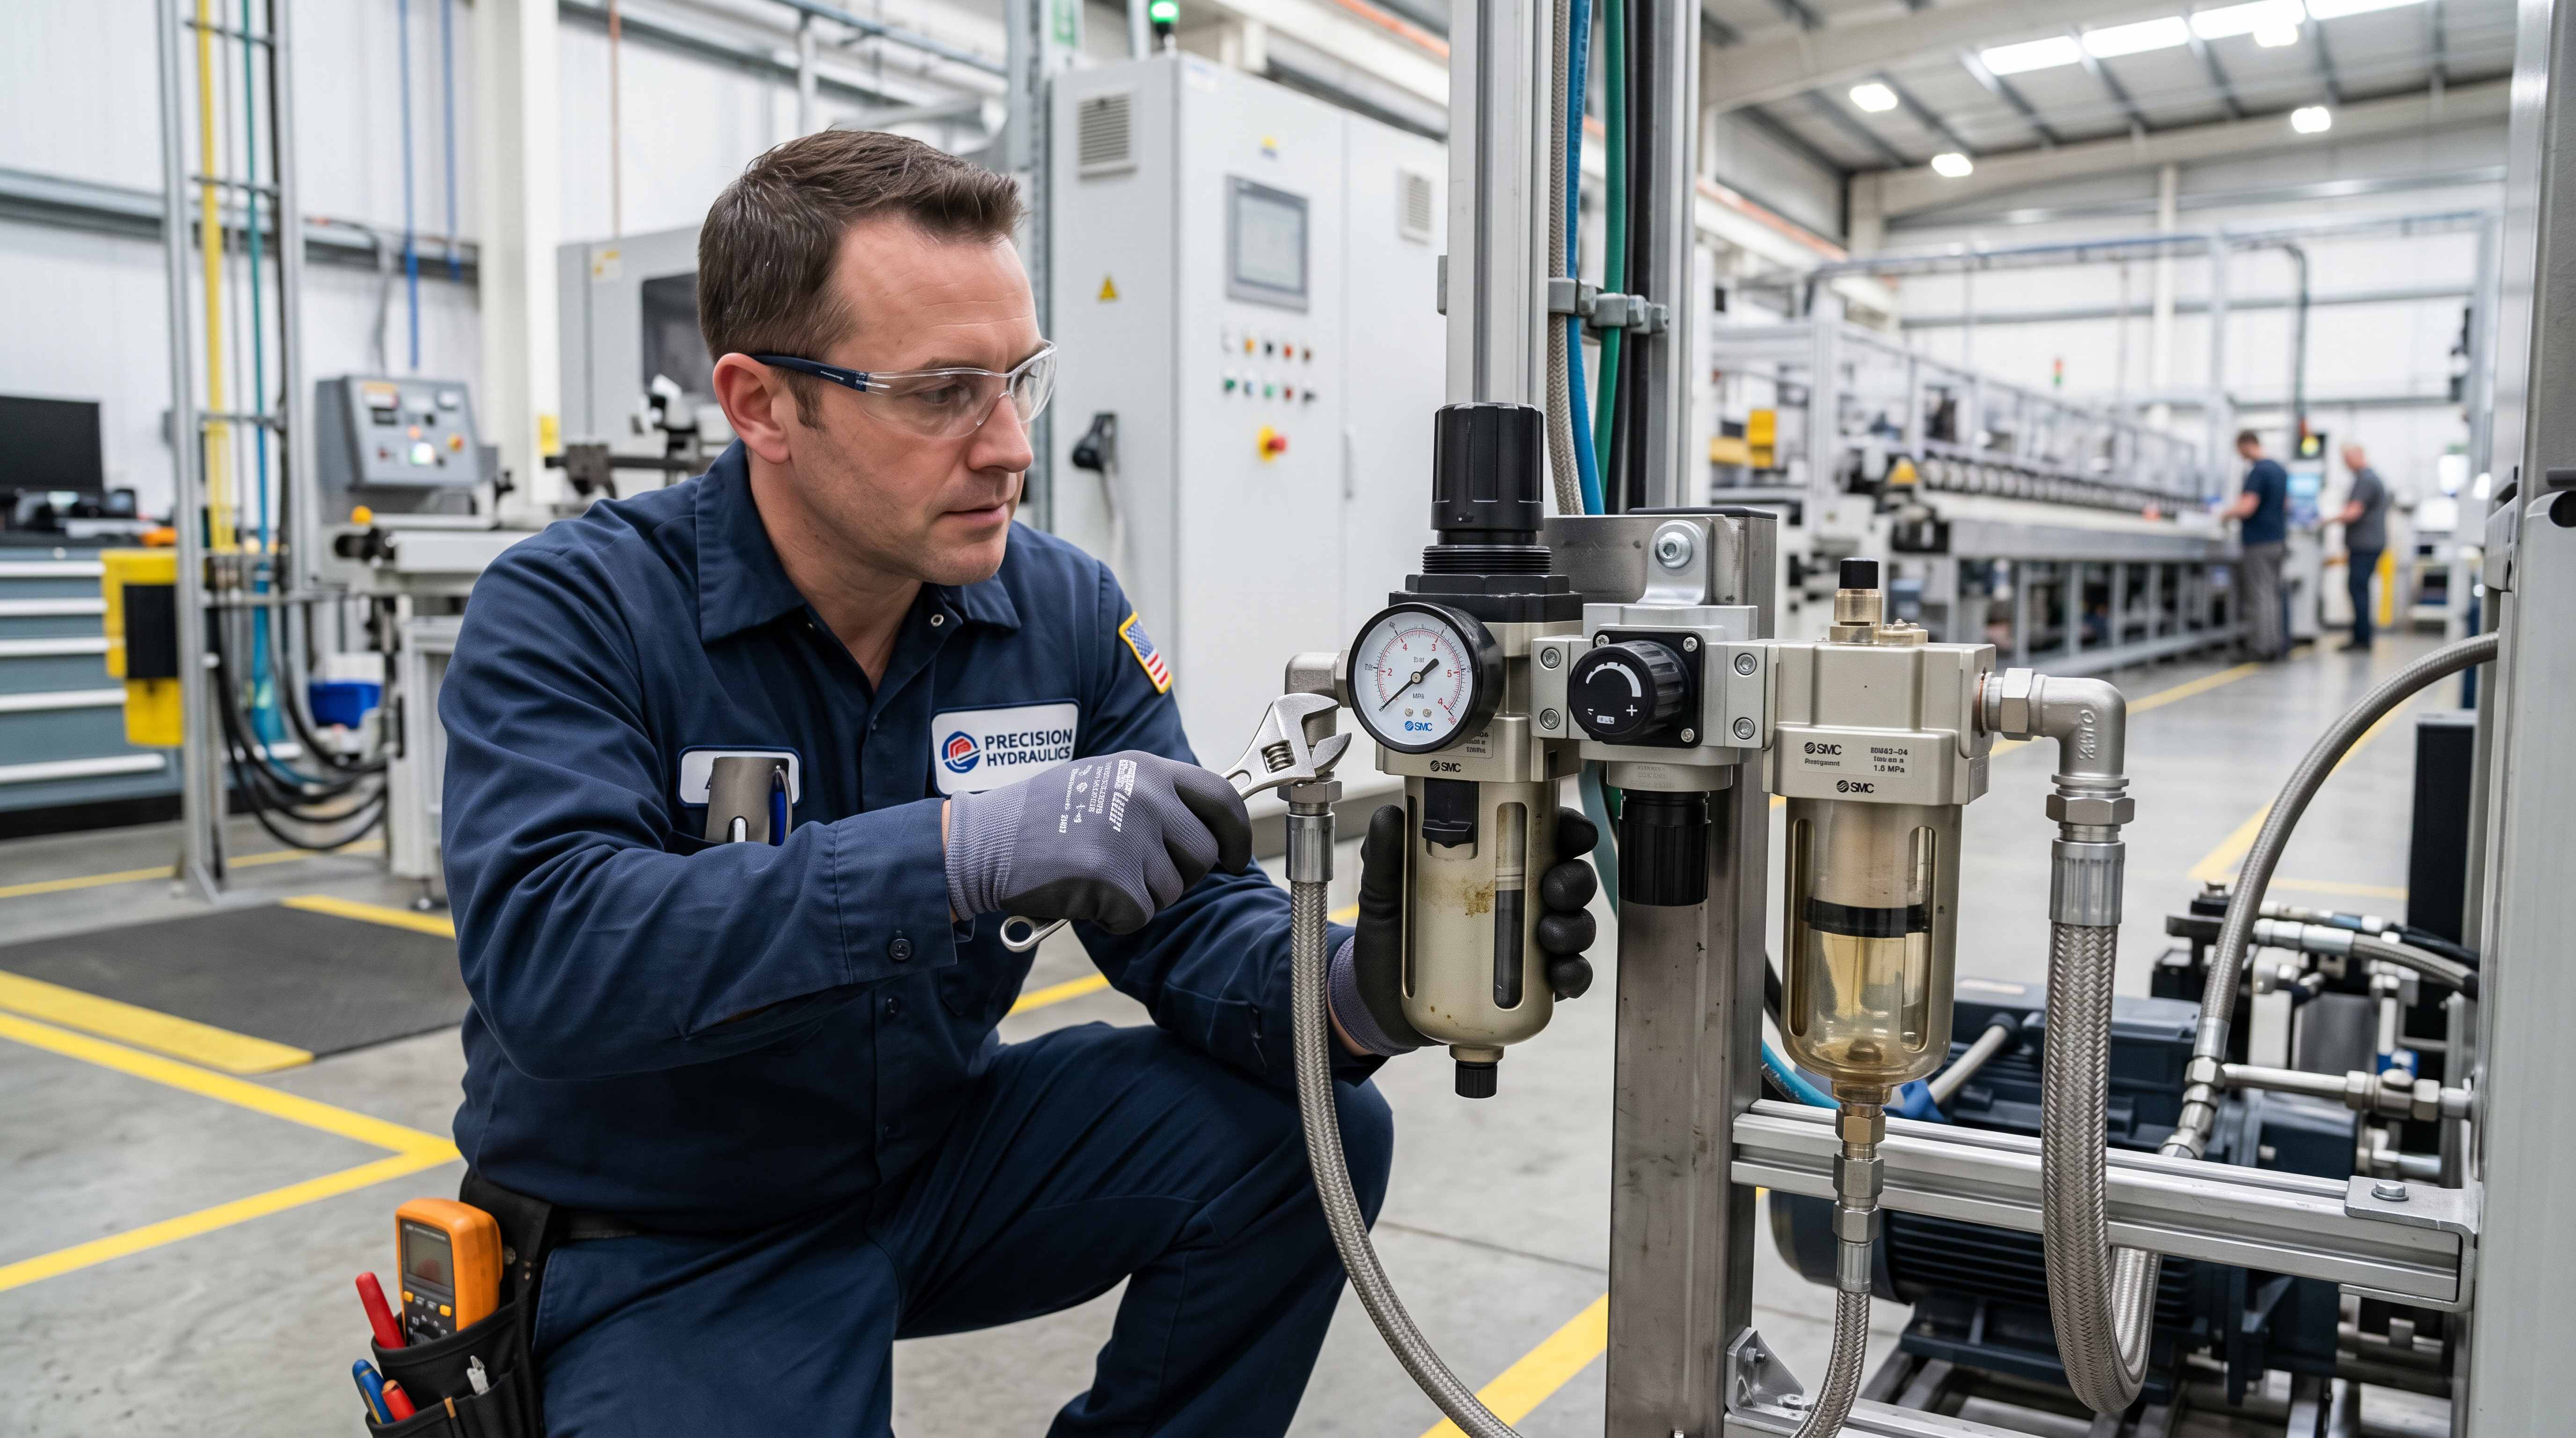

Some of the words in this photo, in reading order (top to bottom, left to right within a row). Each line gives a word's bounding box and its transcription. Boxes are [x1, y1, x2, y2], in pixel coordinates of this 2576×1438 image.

[1414, 722, 1433, 731] SMC
[985, 728, 1073, 750] PRECISION
[1816, 743, 1842, 756] SMC
[986, 746, 1070, 767] HYDRAULICS
[1441, 762, 1461, 773] SMC
[1850, 782, 1874, 793] SMC
